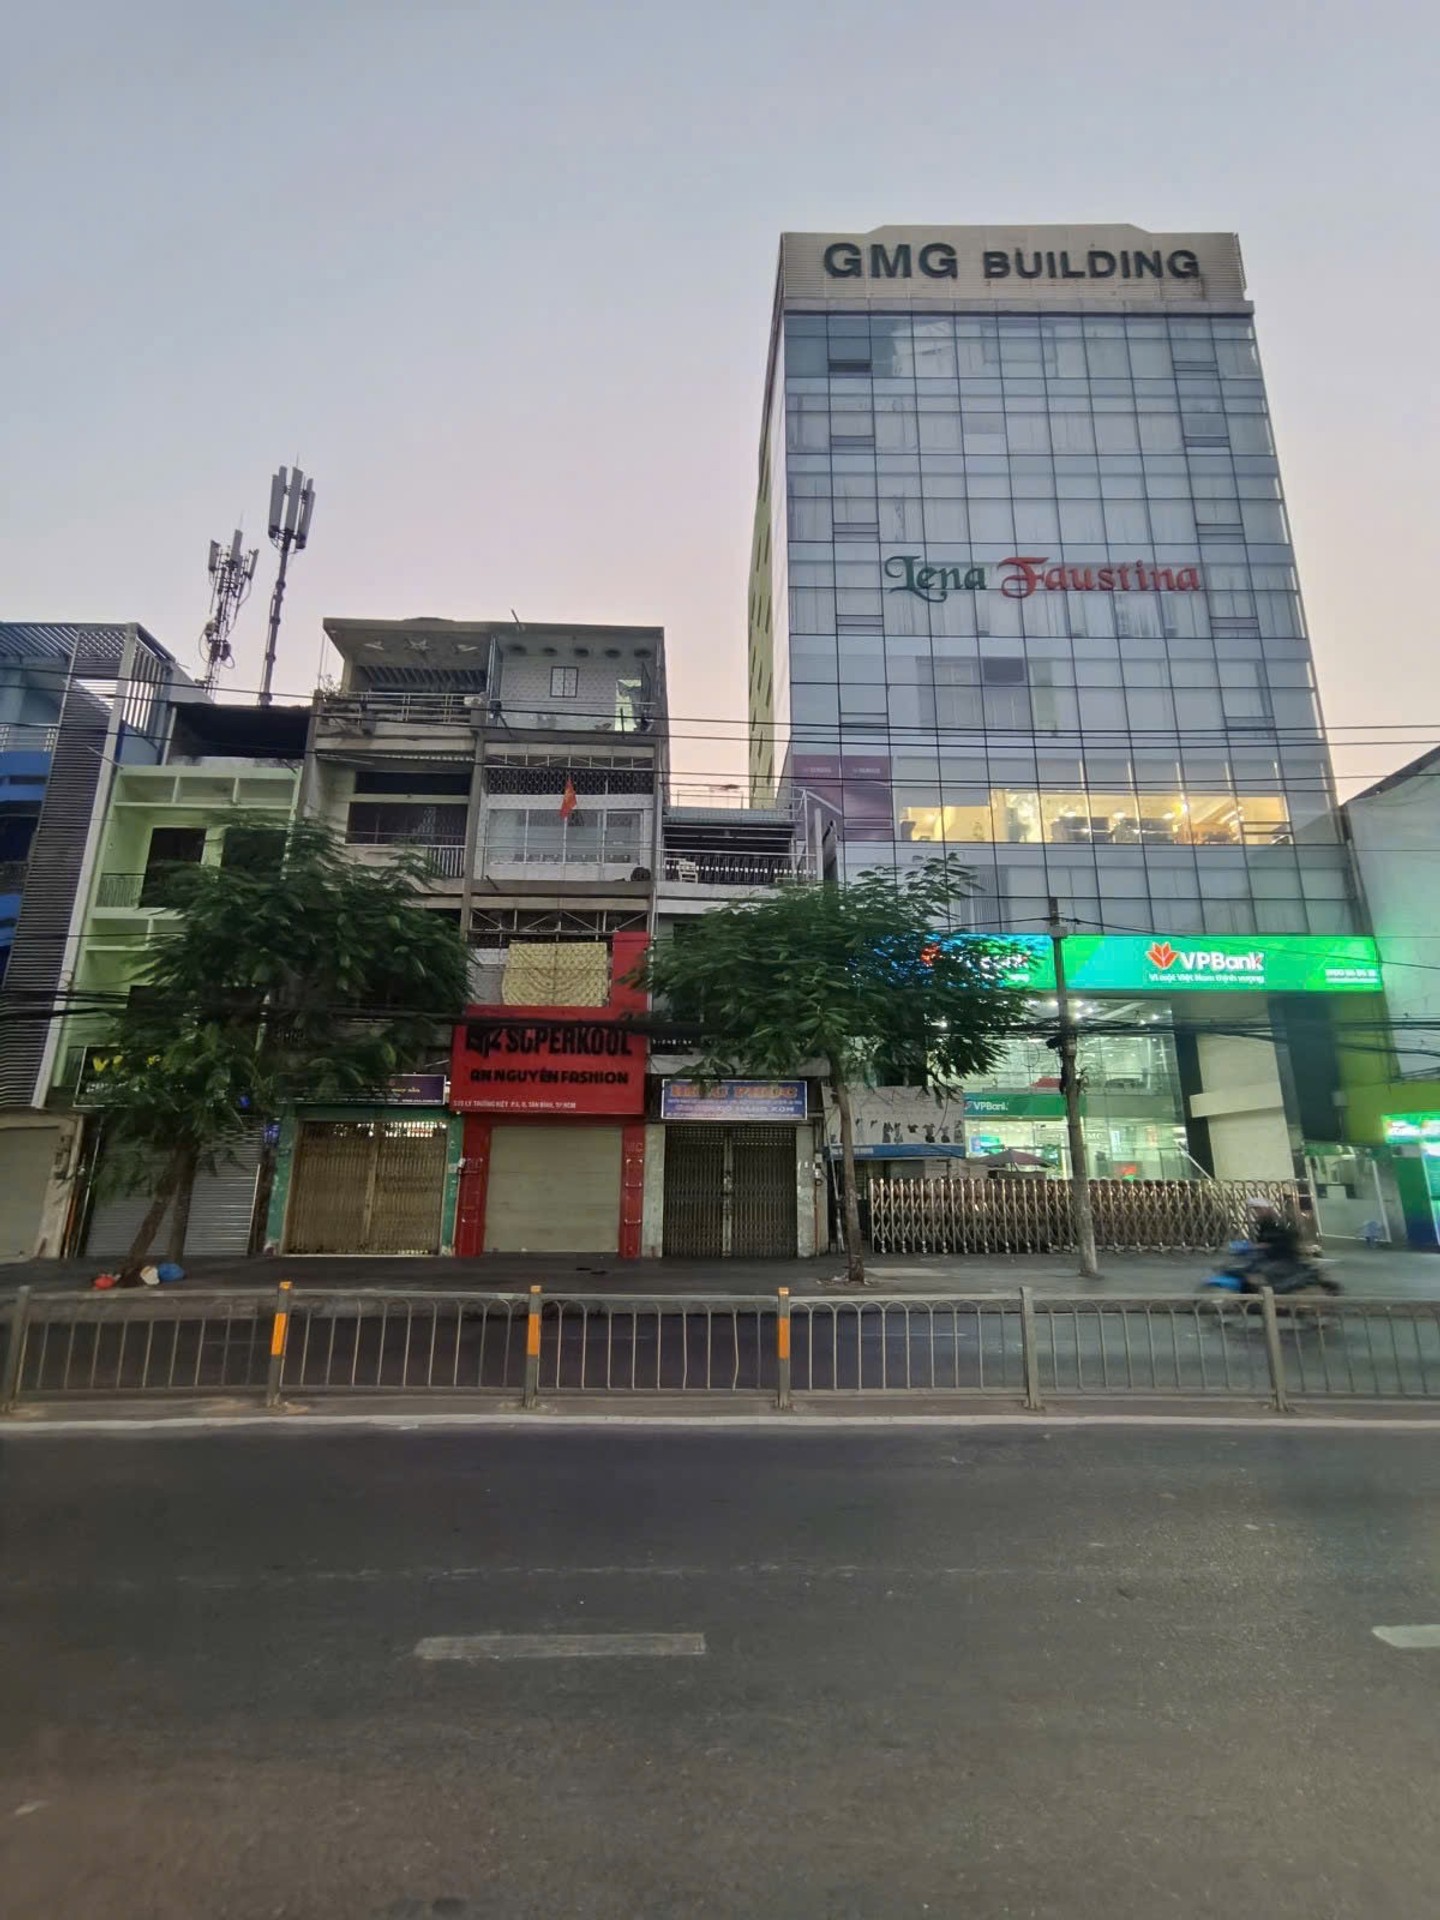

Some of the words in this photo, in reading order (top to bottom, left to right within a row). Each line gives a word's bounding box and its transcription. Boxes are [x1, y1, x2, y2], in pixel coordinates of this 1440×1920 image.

[823, 242, 957, 279] GMG
[983, 250, 1200, 279] BUILDING
[884, 555, 986, 602] Lena
[996, 556, 1200, 598] Faustina
[1179, 951, 1265, 972] VPBank
[561, 1071, 629, 1086] FASHION
